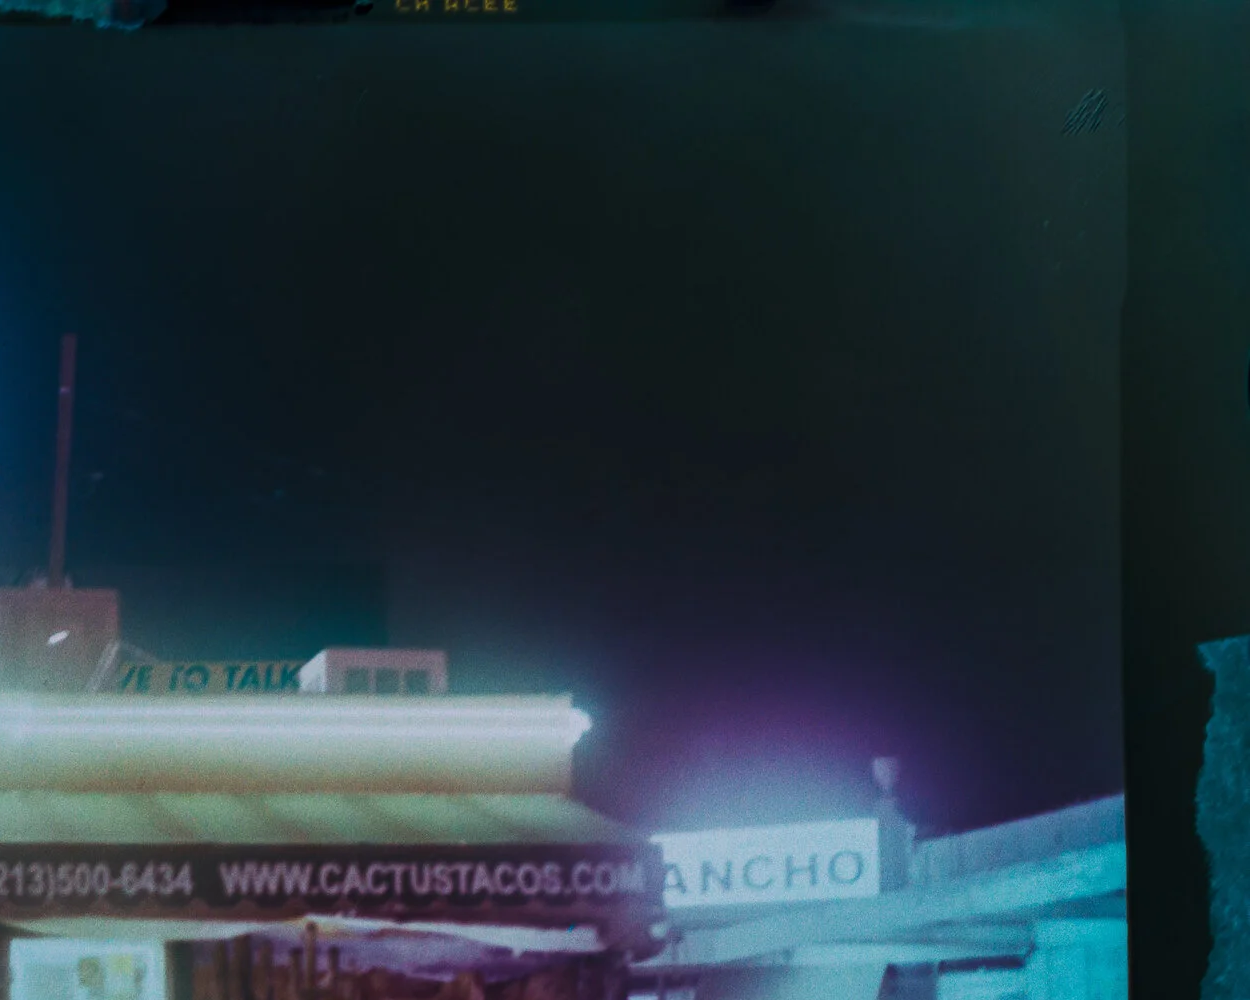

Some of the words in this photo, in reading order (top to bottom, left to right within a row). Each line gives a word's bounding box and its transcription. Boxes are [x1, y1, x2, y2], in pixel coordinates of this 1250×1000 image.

[168, 664, 209, 692] TO
[225, 664, 300, 691] TALK
[219, 861, 644, 897] WWW.CACTUSTACOS.COM
